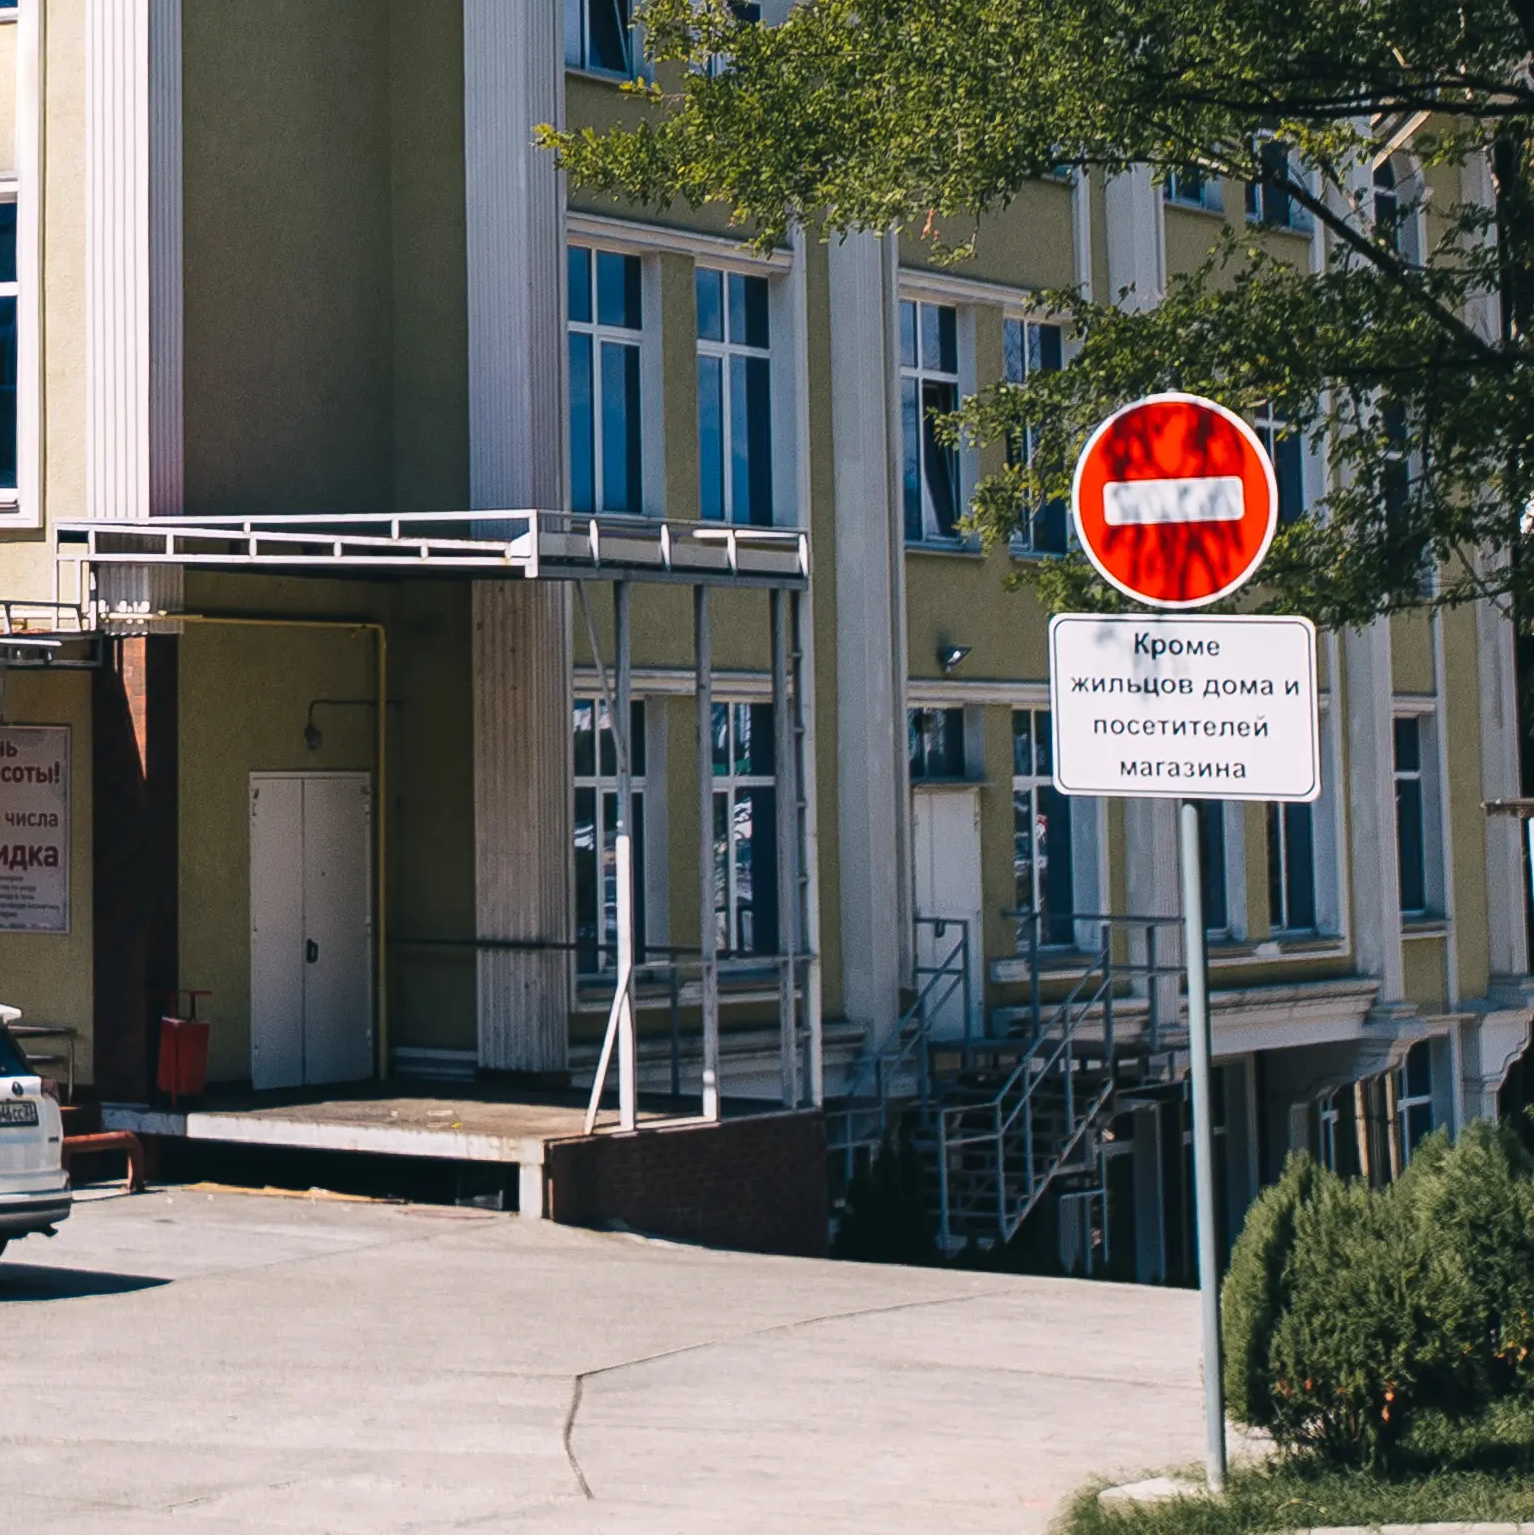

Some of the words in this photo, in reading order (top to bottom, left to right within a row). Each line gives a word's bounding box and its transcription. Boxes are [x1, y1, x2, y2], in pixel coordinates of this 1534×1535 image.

[1134, 632, 1221, 660] Кроме
[1071, 676, 1194, 697] жильцов
[1202, 679, 1275, 698] дома
[1284, 680, 1300, 696] и
[1093, 715, 1269, 738] посетителей
[1120, 760, 1247, 779] магазина
[4, 812, 59, 827] числа
